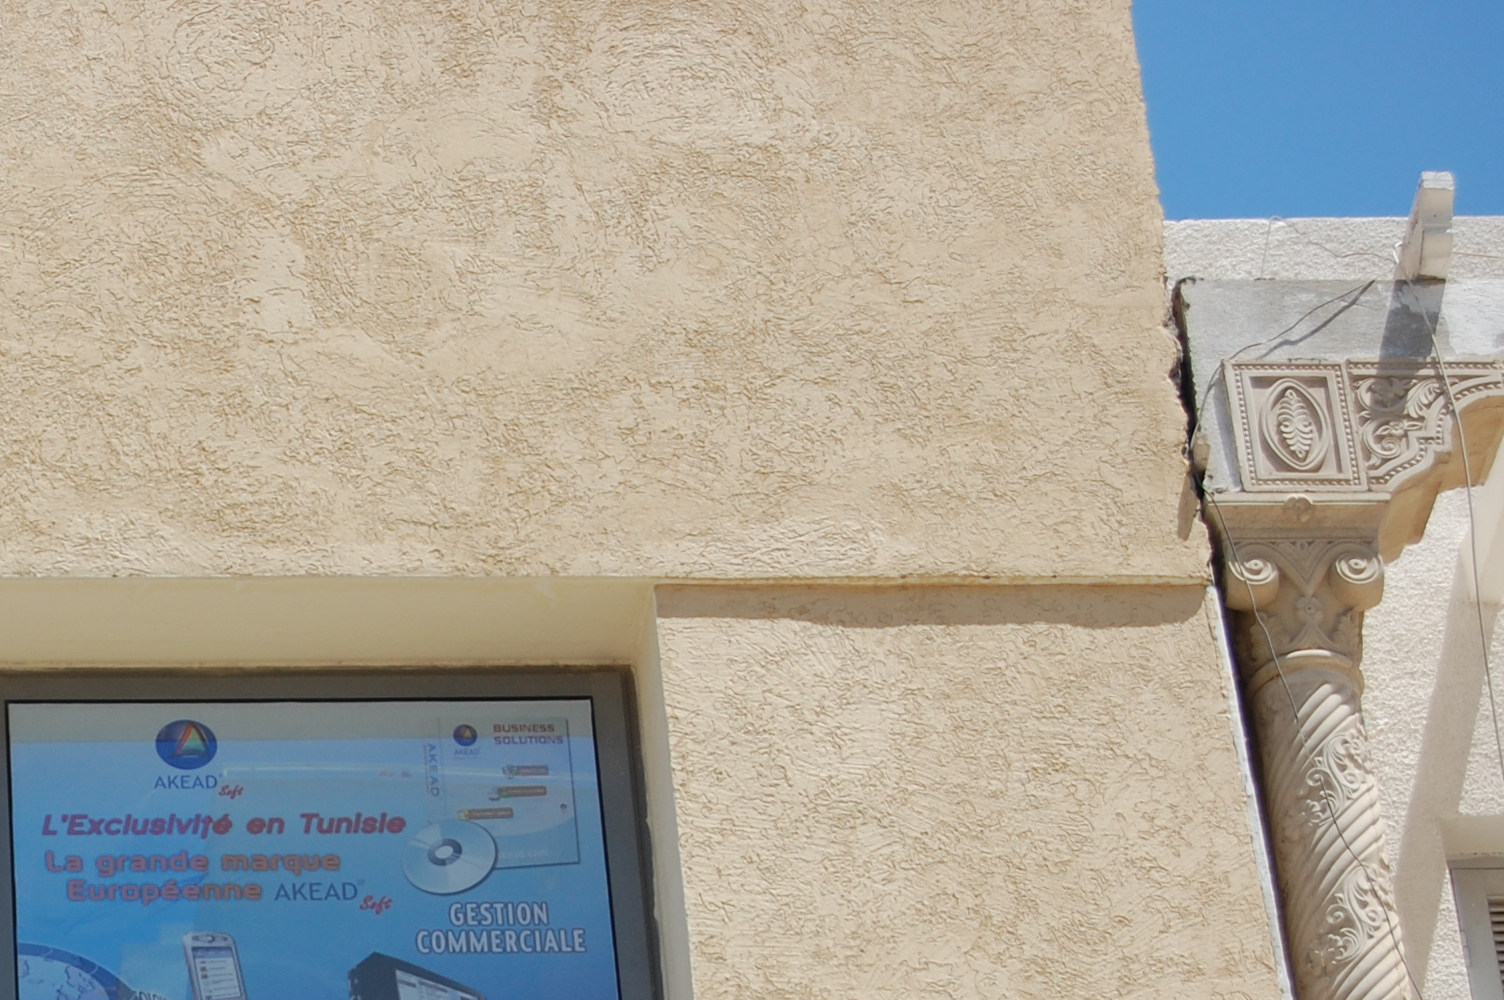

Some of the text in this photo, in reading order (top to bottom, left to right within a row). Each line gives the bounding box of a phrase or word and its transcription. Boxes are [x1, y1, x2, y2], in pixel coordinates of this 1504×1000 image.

[493, 723, 555, 733] BUSINESS
[493, 735, 564, 745] SOLUTIONS
[218, 784, 245, 799] Soft
[41, 812, 407, 839] L'Exclusivité en Tunisie
[45, 850, 342, 877] La grande marque
[66, 877, 263, 905] Européenne
[359, 895, 392, 914] Soft
[449, 902, 549, 927] GESTION
[416, 929, 587, 955] COMMERCIALE
